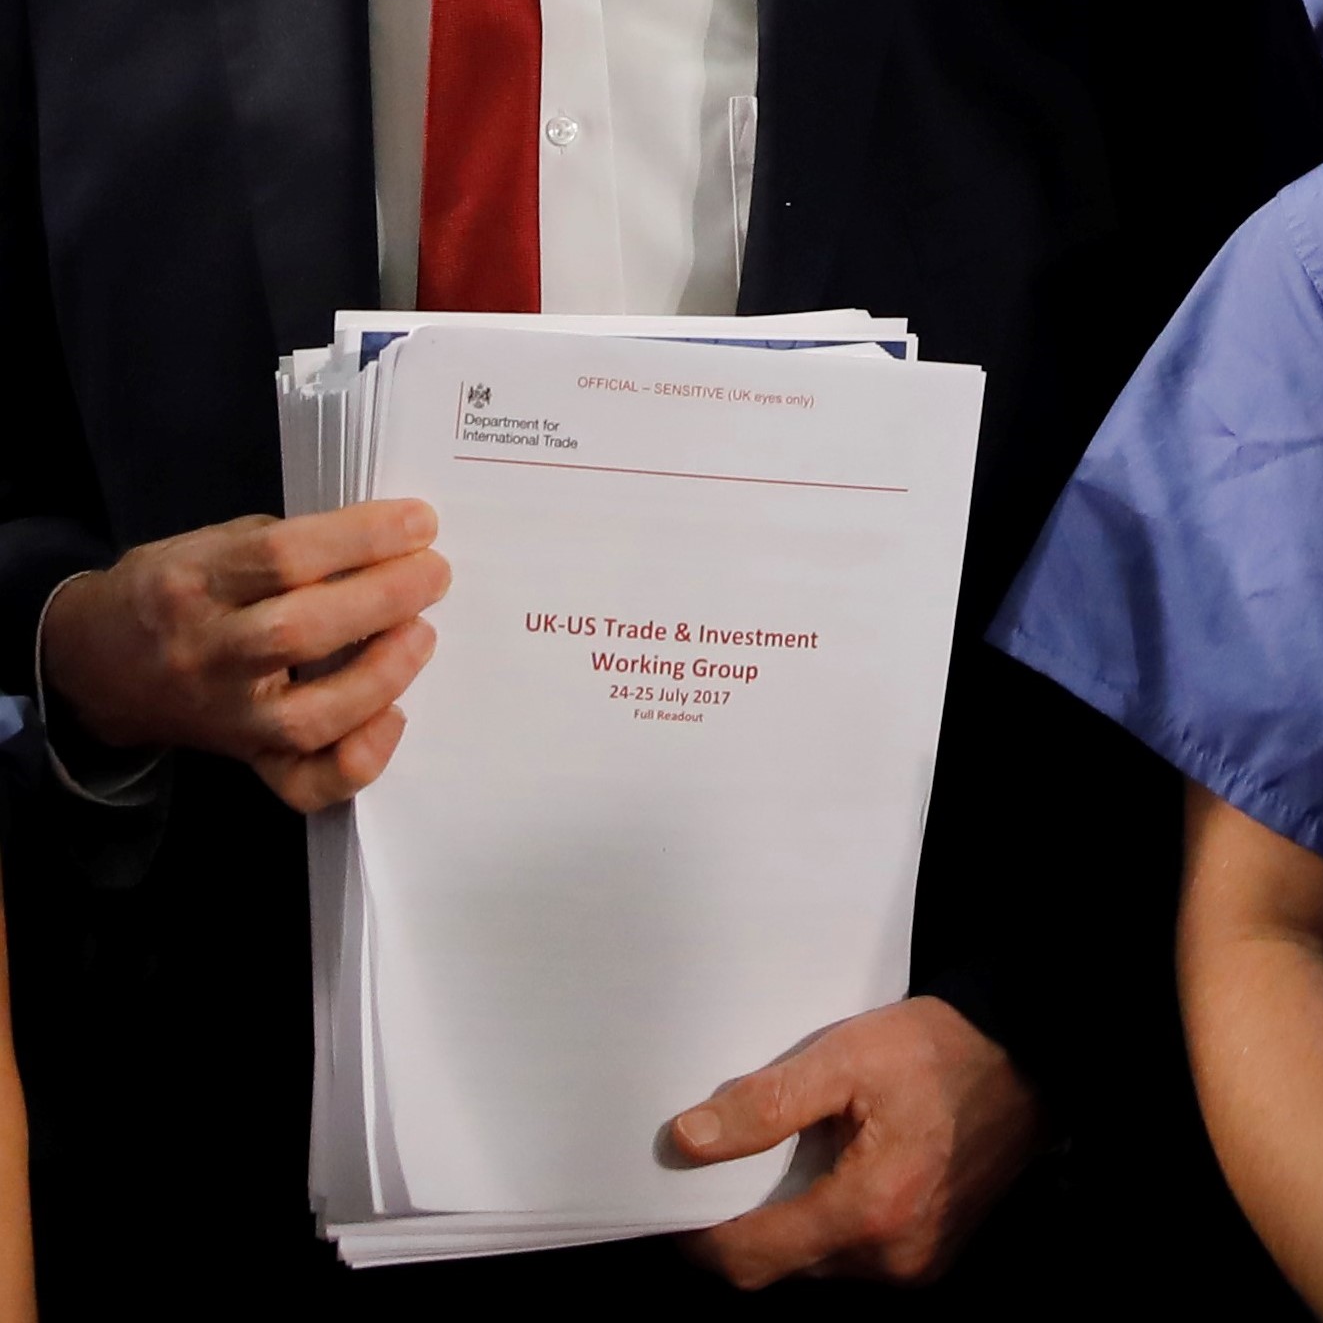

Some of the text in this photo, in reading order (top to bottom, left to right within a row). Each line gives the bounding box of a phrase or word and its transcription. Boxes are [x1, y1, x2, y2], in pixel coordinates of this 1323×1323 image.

[577, 376, 638, 392] OFFICIAL
[654, 383, 724, 399] SENSITIVE
[728, 389, 751, 401] (UK
[754, 394, 782, 405] eyes
[786, 395, 814, 408] only)
[464, 413, 560, 431] Department for
[463, 429, 578, 449] International Trade
[526, 613, 818, 649] UK-US Trade & Investment
[592, 652, 758, 684] Working Group
[610, 685, 730, 706] 24-25 July 2017
[634, 709, 703, 722] Full Readout
